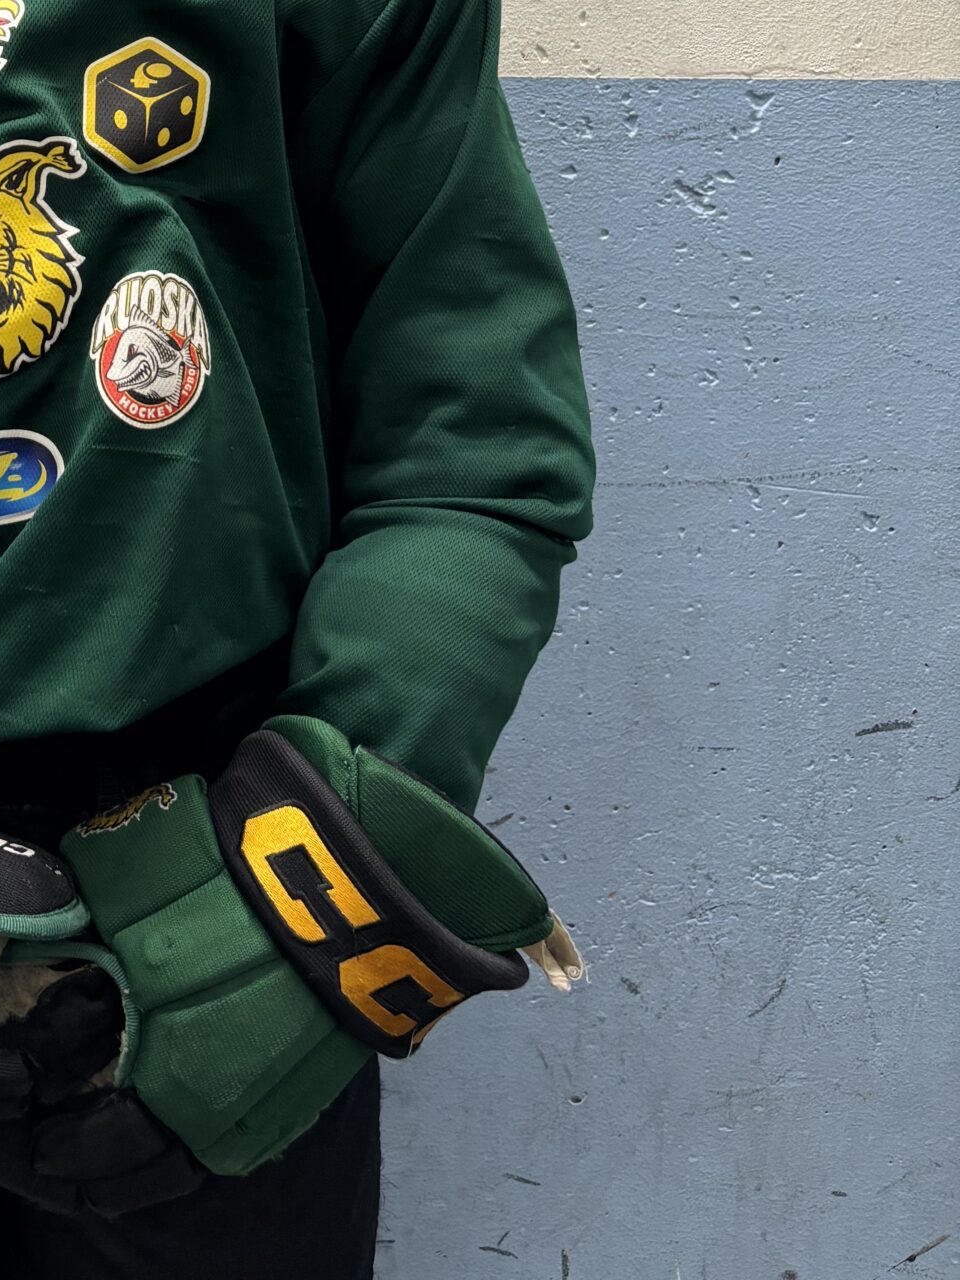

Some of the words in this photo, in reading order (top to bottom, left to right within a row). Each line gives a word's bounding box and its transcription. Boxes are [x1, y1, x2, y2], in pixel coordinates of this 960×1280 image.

[92, 275, 210, 371] RUOSKA
[119, 395, 174, 419] HOCKEY
[241, 805, 466, 1044] CC
